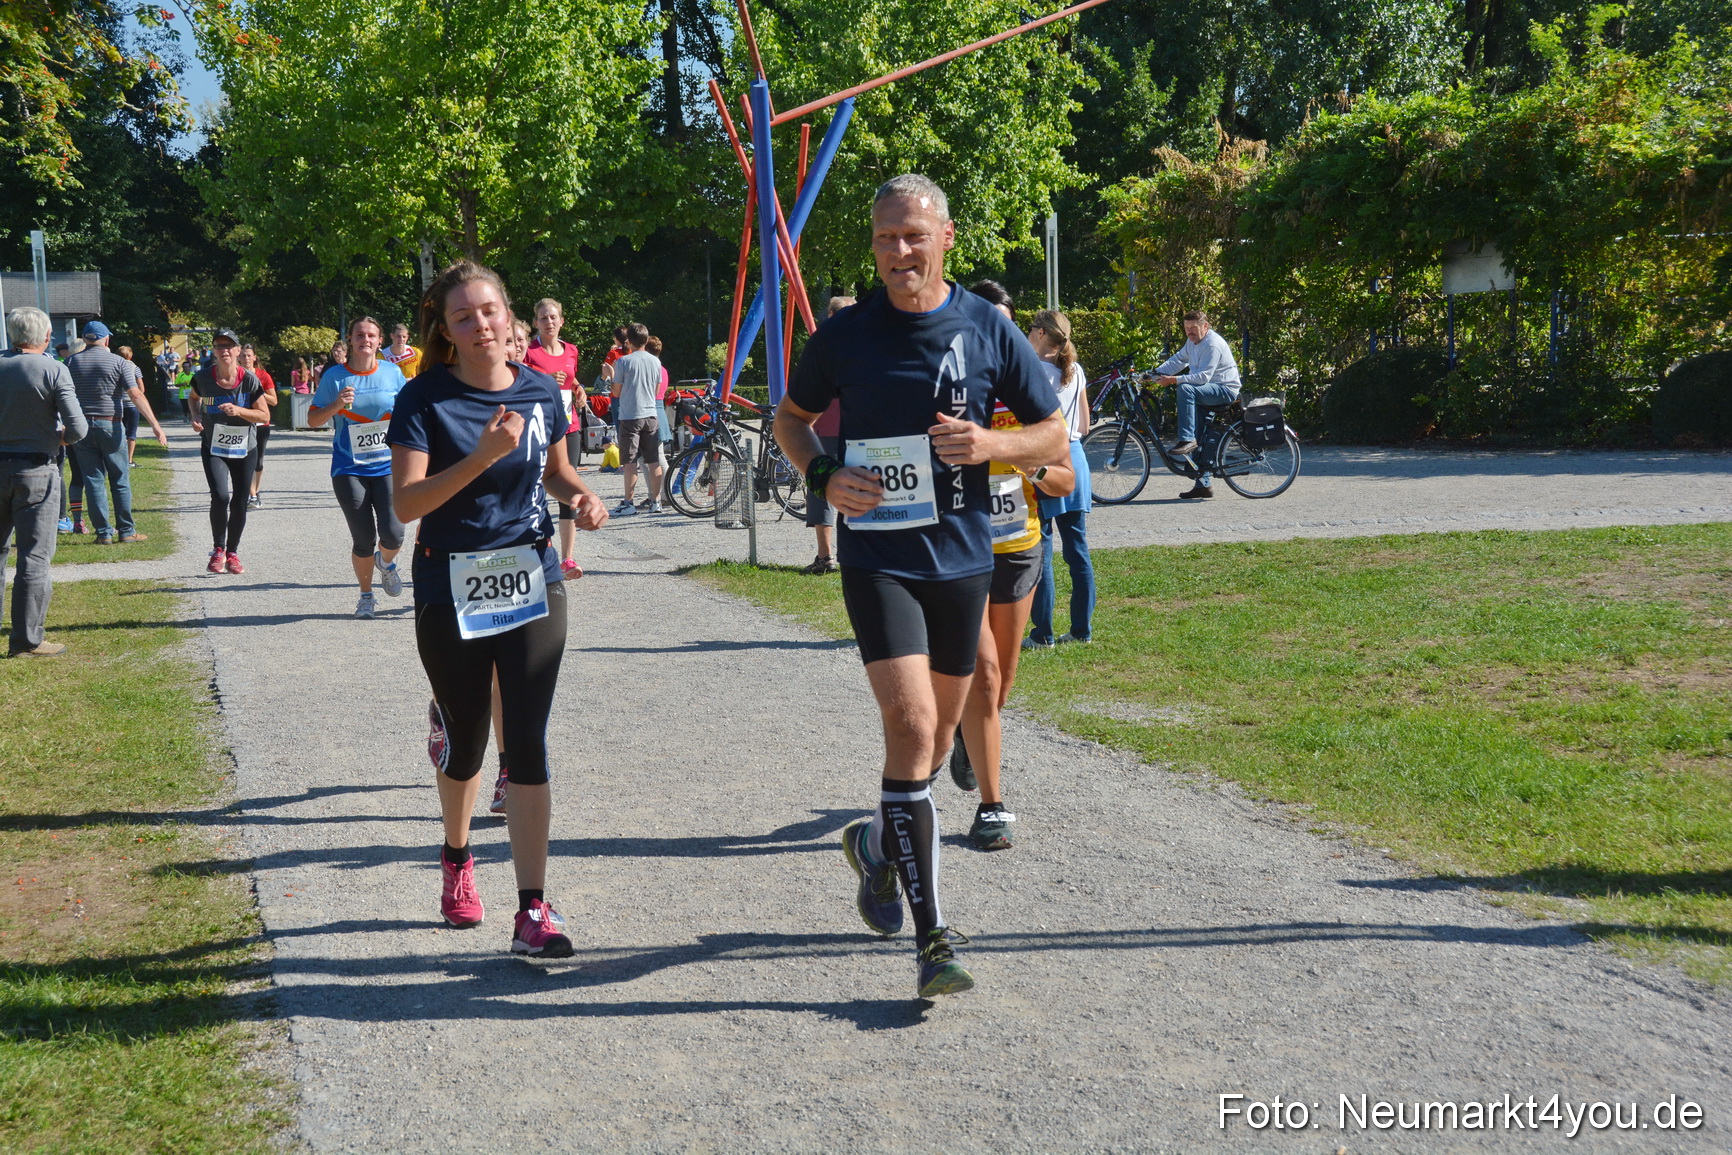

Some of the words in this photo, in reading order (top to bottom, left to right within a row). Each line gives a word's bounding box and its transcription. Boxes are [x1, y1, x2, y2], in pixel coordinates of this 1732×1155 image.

[217, 433, 243, 445] 2285
[357, 432, 388, 447] 2302
[866, 447, 901, 457] BOCK
[990, 493, 1016, 516] 05
[871, 508, 909, 520] Jochen
[477, 556, 517, 569] BOCK
[465, 570, 531, 602] 2390
[494, 600, 521, 609] Neumarkt
[492, 613, 515, 626] Rita
[887, 807, 923, 904] kalenji
